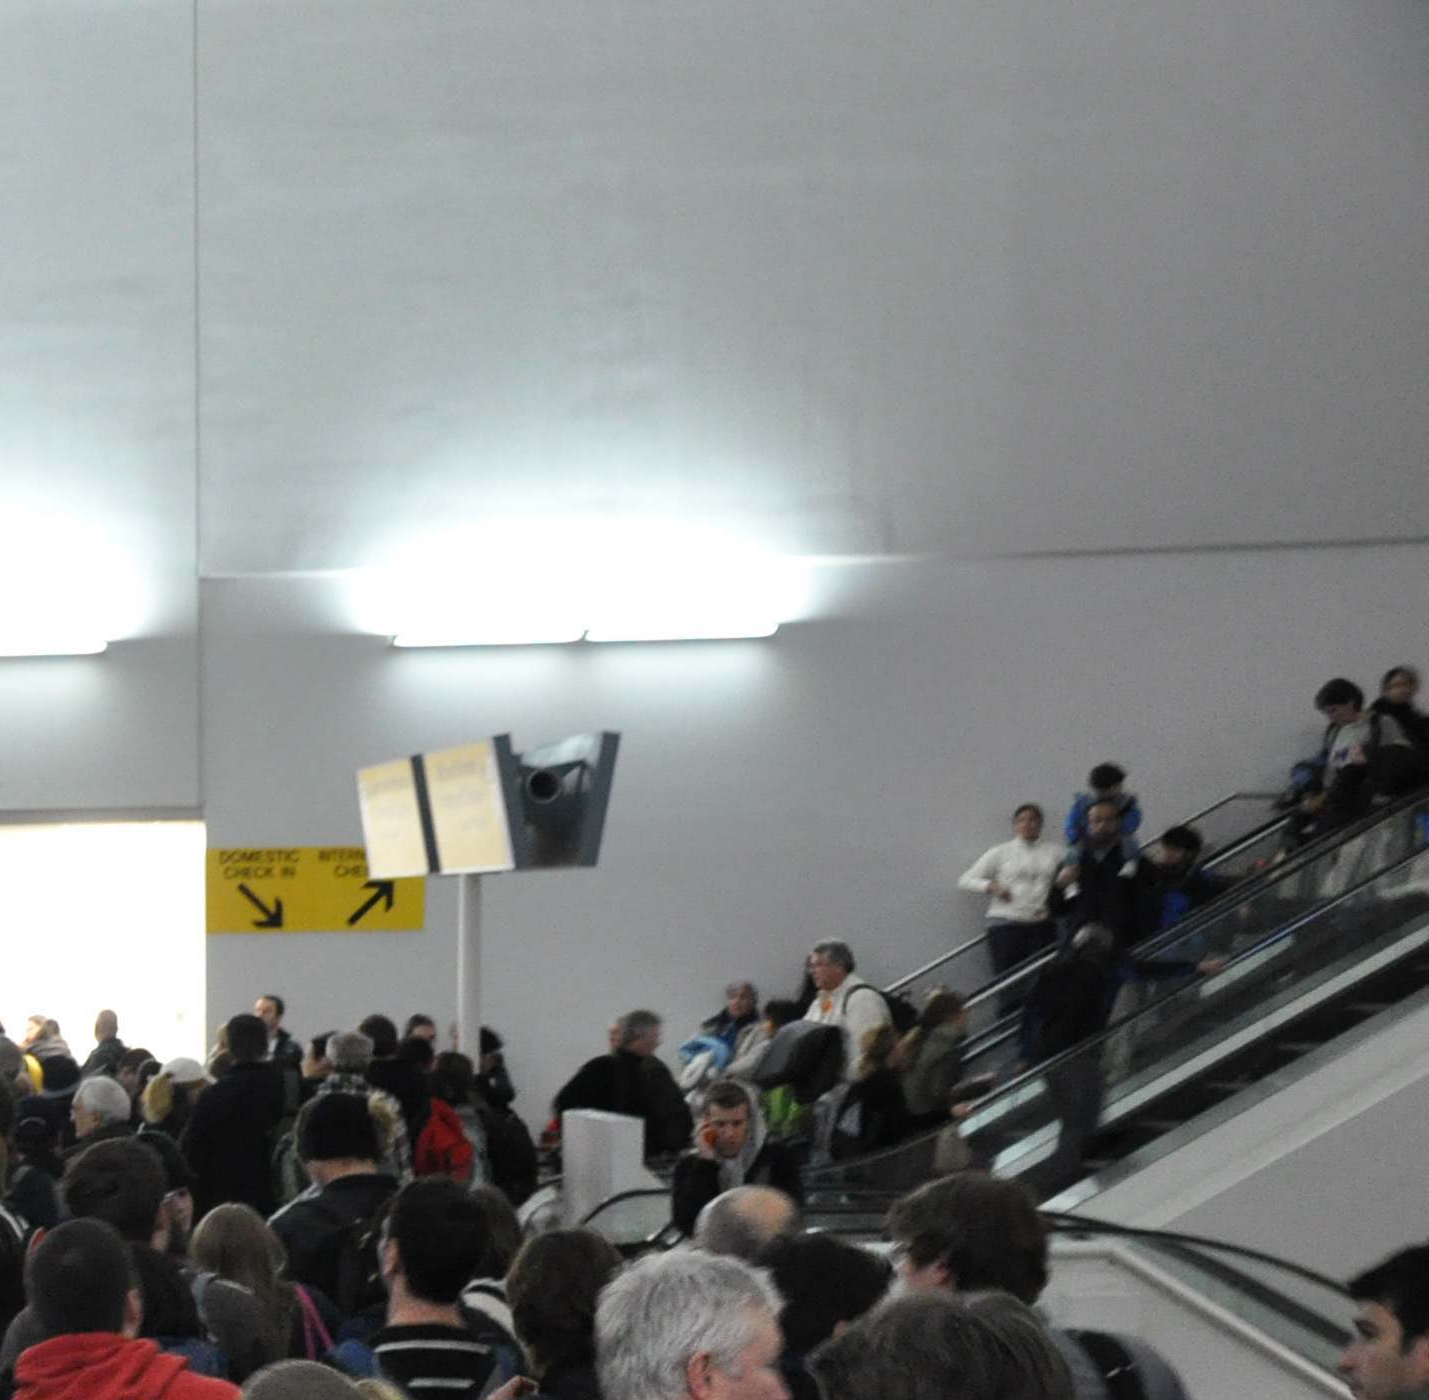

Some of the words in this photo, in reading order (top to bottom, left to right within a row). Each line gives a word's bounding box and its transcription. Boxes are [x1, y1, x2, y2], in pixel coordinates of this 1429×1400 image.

[219, 849, 300, 864] DOMESTIC
[223, 866, 274, 879] CHECK
[281, 866, 296, 878] IN
